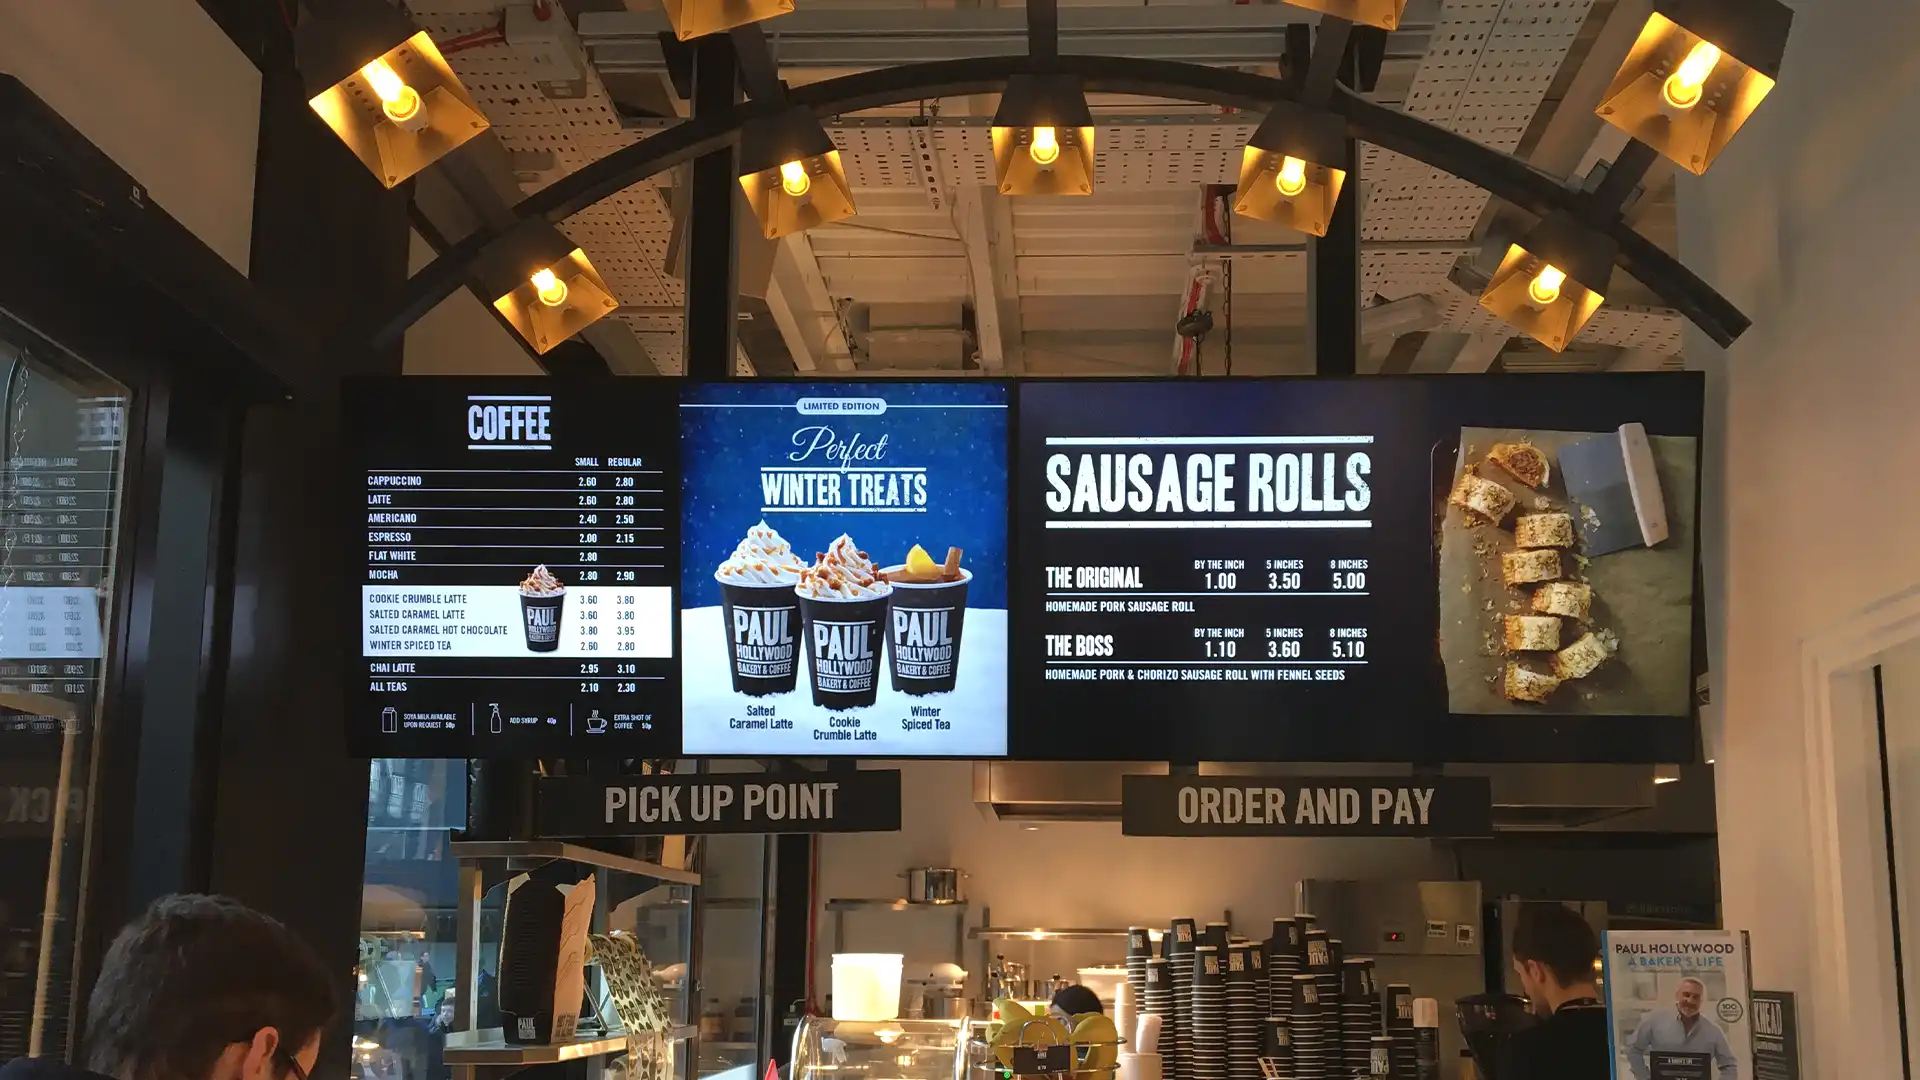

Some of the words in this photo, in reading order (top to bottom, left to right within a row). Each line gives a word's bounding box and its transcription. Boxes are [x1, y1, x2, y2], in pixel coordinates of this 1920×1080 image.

[468, 405, 551, 441] COFFEE
[789, 425, 888, 474] Perfect
[575, 457, 599, 467] SMALL
[608, 457, 642, 467] REGULAR
[368, 476, 421, 486] CAPPUCCINO
[578, 477, 596, 487] 2.60
[615, 477, 633, 487] 2.80
[1046, 453, 1235, 513] SAUSAGE
[1249, 452, 1372, 512] ROLLS
[761, 473, 841, 506] WINTER
[847, 473, 927, 506] TREATS
[368, 495, 391, 504] LATTE
[579, 496, 597, 505] 2.60
[616, 496, 634, 505] 2.80
[368, 513, 417, 523] AMERICANO
[579, 514, 597, 524] 2.40
[616, 514, 634, 524] 2.50
[368, 532, 411, 542] ESPRESSO
[579, 533, 597, 543] 2.00
[616, 533, 634, 543] 2.15
[369, 551, 388, 561] FLAT
[389, 551, 416, 561] WHITE
[579, 552, 597, 562] 2.80
[1195, 560, 1205, 570] BY
[1207, 560, 1223, 570] THE
[1226, 560, 1244, 570] INCH
[1266, 560, 1271, 569] 5
[1274, 560, 1304, 570] INCHES
[1331, 560, 1335, 569] 8
[1338, 560, 1368, 570] INCHES
[369, 570, 398, 580] MOCHA
[580, 571, 598, 581] 2.80
[616, 571, 635, 581] 2.90
[1046, 567, 1073, 588] THE
[1076, 567, 1143, 589] ORIGINAL
[1205, 573, 1236, 589] 1.00
[1269, 573, 1300, 589] 3.50
[1333, 573, 1365, 589] 5.00
[369, 594, 399, 604] COOKIE
[402, 594, 441, 604] CRUMBLE
[445, 594, 467, 604] LATTE
[580, 595, 598, 605] 3.60
[617, 595, 635, 605] 3.80
[1046, 602, 1097, 612] HOMEMADE
[1100, 602, 1125, 612] PORK
[1127, 602, 1169, 612] SAUSAGE
[1172, 602, 1195, 612] ROLL
[370, 609, 399, 620] SALTED
[402, 609, 440, 620] CARAMEL
[443, 609, 465, 620] LATTE
[580, 611, 598, 620] 3.60
[617, 611, 635, 620] 3.80
[527, 608, 557, 626] PAUL
[370, 625, 399, 635] SALTED
[402, 625, 440, 635] CARAMEL
[443, 625, 458, 635] HOT
[461, 625, 507, 635] CHOCOLATE
[580, 626, 598, 636] 3.80
[617, 626, 635, 636] 3.95
[734, 609, 793, 645] PAUL
[893, 610, 952, 646] PAUL
[1195, 628, 1205, 638] BY
[1207, 628, 1223, 638] THE
[1225, 628, 1244, 638] INCH
[1266, 628, 1271, 638] 5
[1274, 628, 1303, 638] INCHES
[1330, 628, 1335, 638] 8
[1338, 628, 1367, 638] INCHES
[370, 640, 401, 651] WINTER
[404, 640, 435, 651] SPICED
[437, 640, 451, 651] TEA
[580, 641, 598, 651] 2.60
[617, 641, 635, 651] 2.80
[814, 624, 873, 660] PAUL
[1046, 635, 1073, 657] THE
[1076, 635, 1114, 657] BOSS
[1205, 641, 1236, 658] 1.10
[1268, 641, 1300, 658] 3.60
[1333, 641, 1365, 658] 5.10
[736, 644, 792, 660] HOLLYWOOD
[896, 645, 952, 661] HOLLYWOOD
[370, 663, 390, 673] CHAI
[393, 663, 415, 673] LATTE
[581, 664, 598, 674] 2.95
[617, 664, 635, 674] 3.10
[737, 662, 761, 675] BAKERY
[769, 662, 791, 674] COFFEE
[816, 659, 872, 674] HOLLYWOOD
[897, 663, 921, 675] BAKERY
[928, 662, 951, 675] COFFEE
[1046, 670, 1097, 681] HOMEMADE
[1100, 670, 1125, 681] PORK
[1128, 670, 1135, 681] &
[1138, 670, 1179, 681] CHORIZO
[1181, 670, 1223, 681] SAUSAGE
[1225, 670, 1248, 681] ROLL
[1251, 670, 1275, 681] WITH
[1278, 670, 1312, 681] FENNEL
[1315, 670, 1345, 681] SEEDS
[370, 682, 384, 692] ALL
[386, 682, 407, 692] TEAS
[581, 683, 599, 693] 2.10
[617, 683, 635, 693] 2.30
[818, 676, 841, 689] BAKERY
[849, 676, 871, 689] COFFEE
[747, 705, 775, 717] Salted
[911, 706, 941, 717] Winter
[730, 718, 768, 729] Caramel
[771, 718, 793, 729] Latte
[829, 716, 860, 728] Cookie
[902, 719, 932, 731] Spiced
[934, 719, 950, 730] Tea
[814, 729, 852, 740] Crumble
[855, 729, 877, 740] Latte
[606, 786, 682, 823] PICK
[691, 785, 733, 821] UP
[744, 783, 838, 820] POINT
[1178, 787, 1286, 824] ORDER
[1295, 788, 1359, 825] AND
[1371, 788, 1435, 825] PAY
[1615, 943, 1646, 954] PAUL
[1649, 943, 1735, 954] HOLLYWOOD
[1628, 957, 1637, 967] A
[1641, 957, 1692, 967] BAKER'S
[1697, 957, 1723, 967] LIFE
[518, 1017, 535, 1030] PAUL
